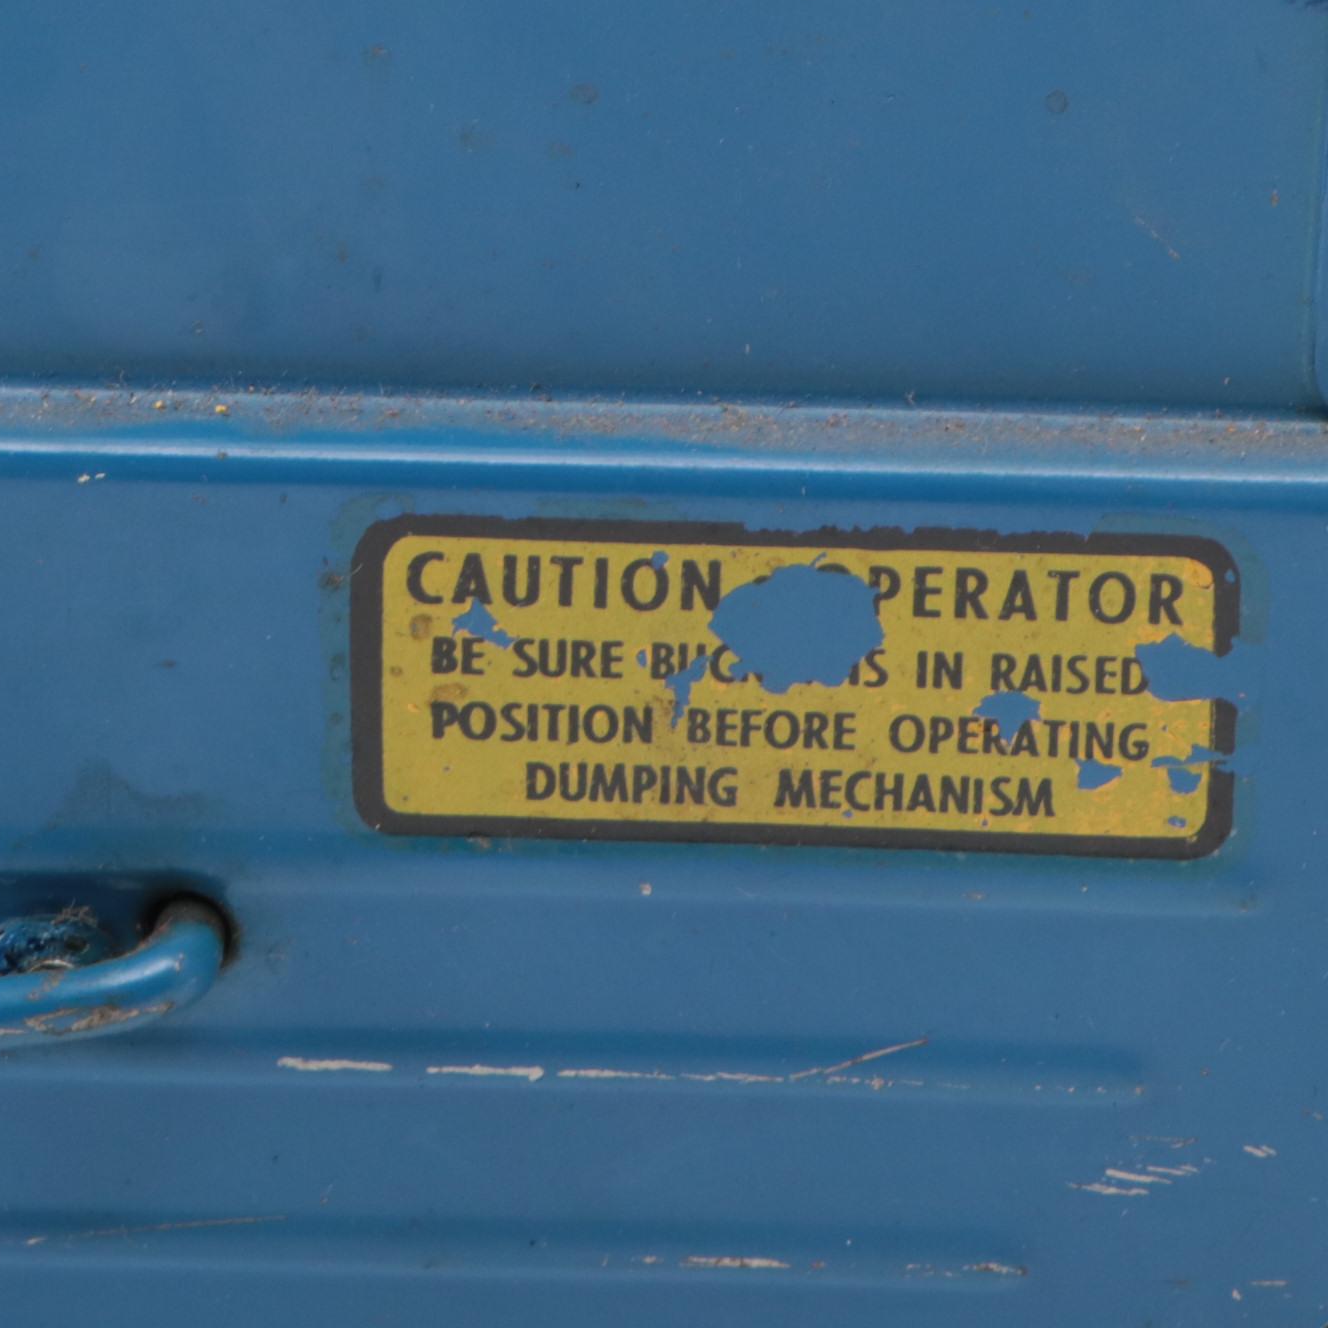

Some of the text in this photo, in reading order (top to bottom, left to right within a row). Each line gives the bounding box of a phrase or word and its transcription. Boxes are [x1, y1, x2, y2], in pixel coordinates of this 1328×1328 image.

[405, 550, 1184, 626] CAUTION PERATOR
[430, 636, 485, 676] BE
[512, 638, 624, 679] SURE
[915, 650, 963, 690] IN
[990, 653, 1150, 696] RAISED
[430, 701, 1151, 762] POSITION BEFORE OPERATING
[524, 761, 1056, 818] DUMPING MECHANISM
